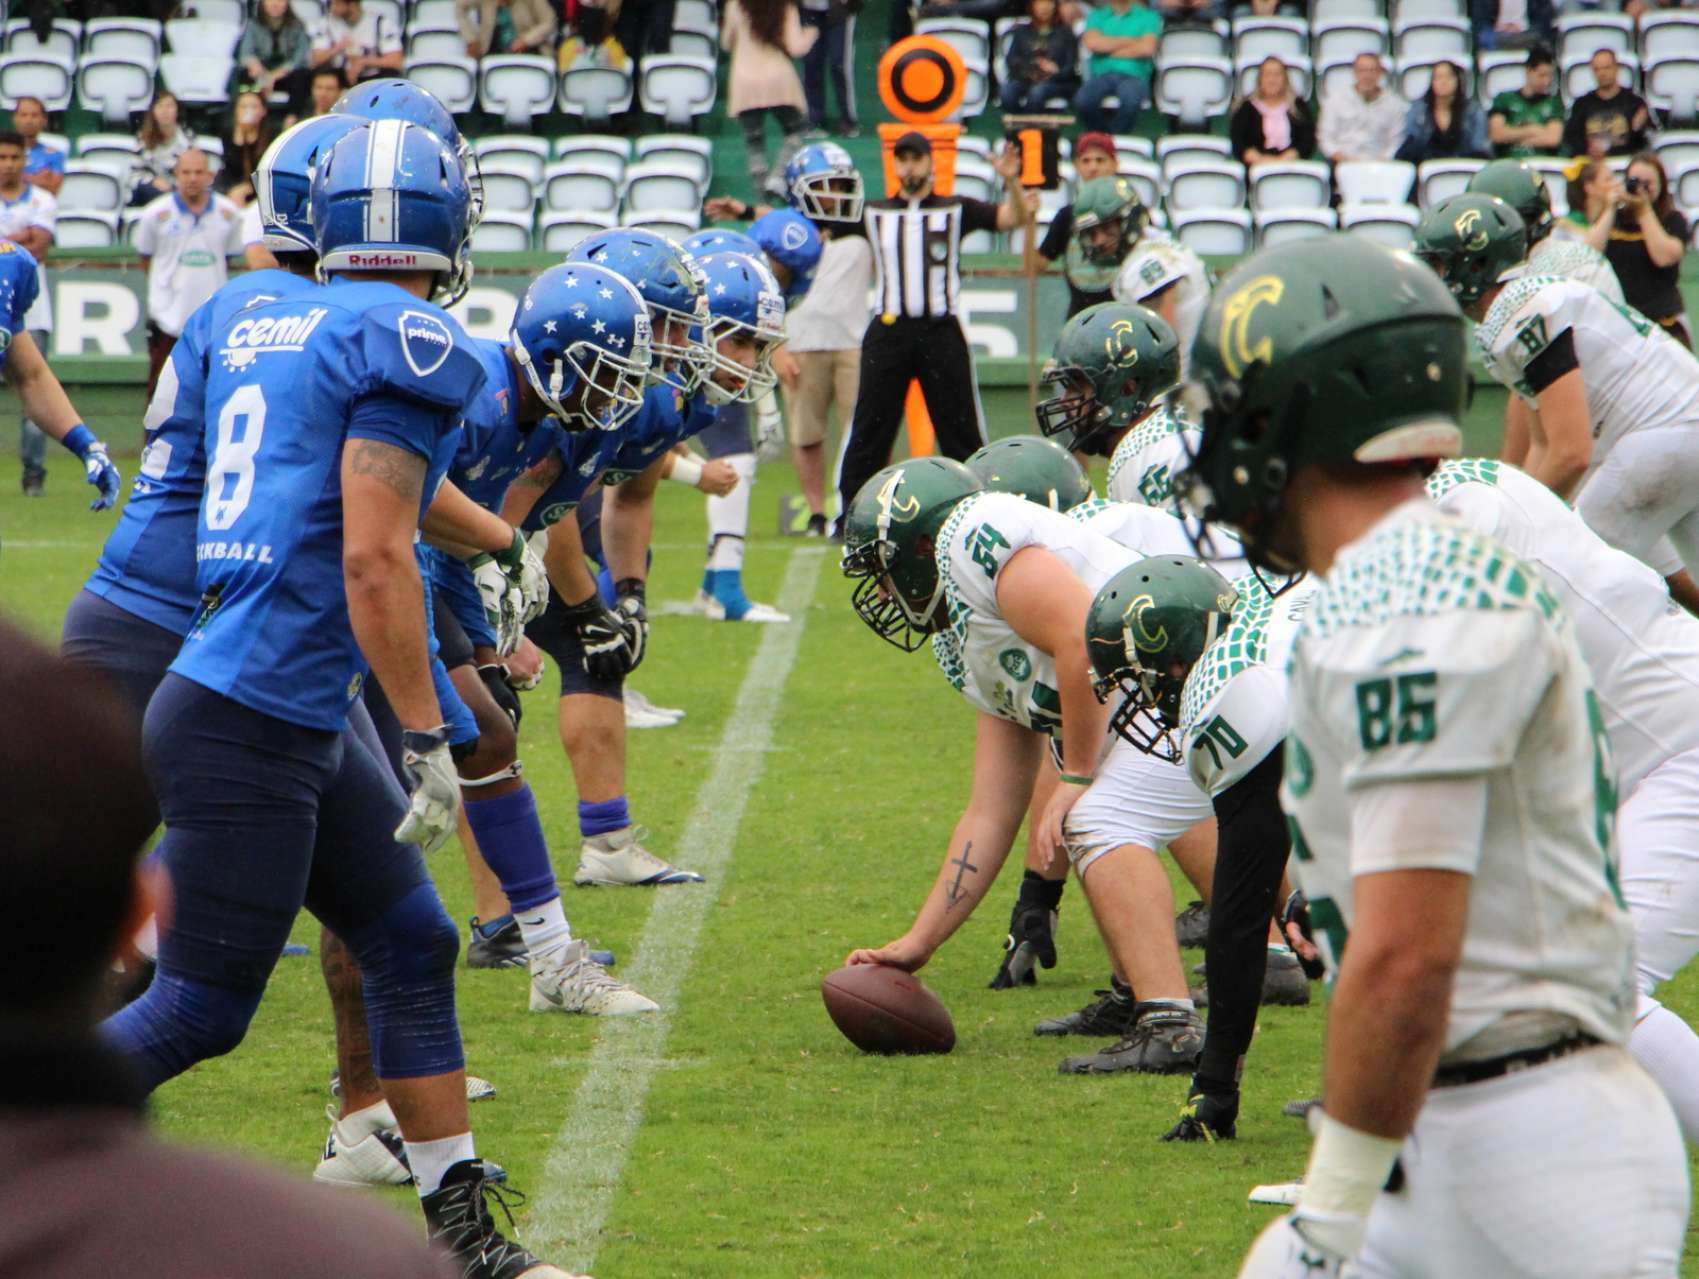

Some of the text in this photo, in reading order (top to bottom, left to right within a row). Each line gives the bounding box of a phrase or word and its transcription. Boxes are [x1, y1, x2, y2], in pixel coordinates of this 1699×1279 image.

[227, 308, 328, 347] cemil
[408, 327, 448, 345] prime
[206, 384, 267, 530] 8
[1192, 714, 1249, 770] 70
